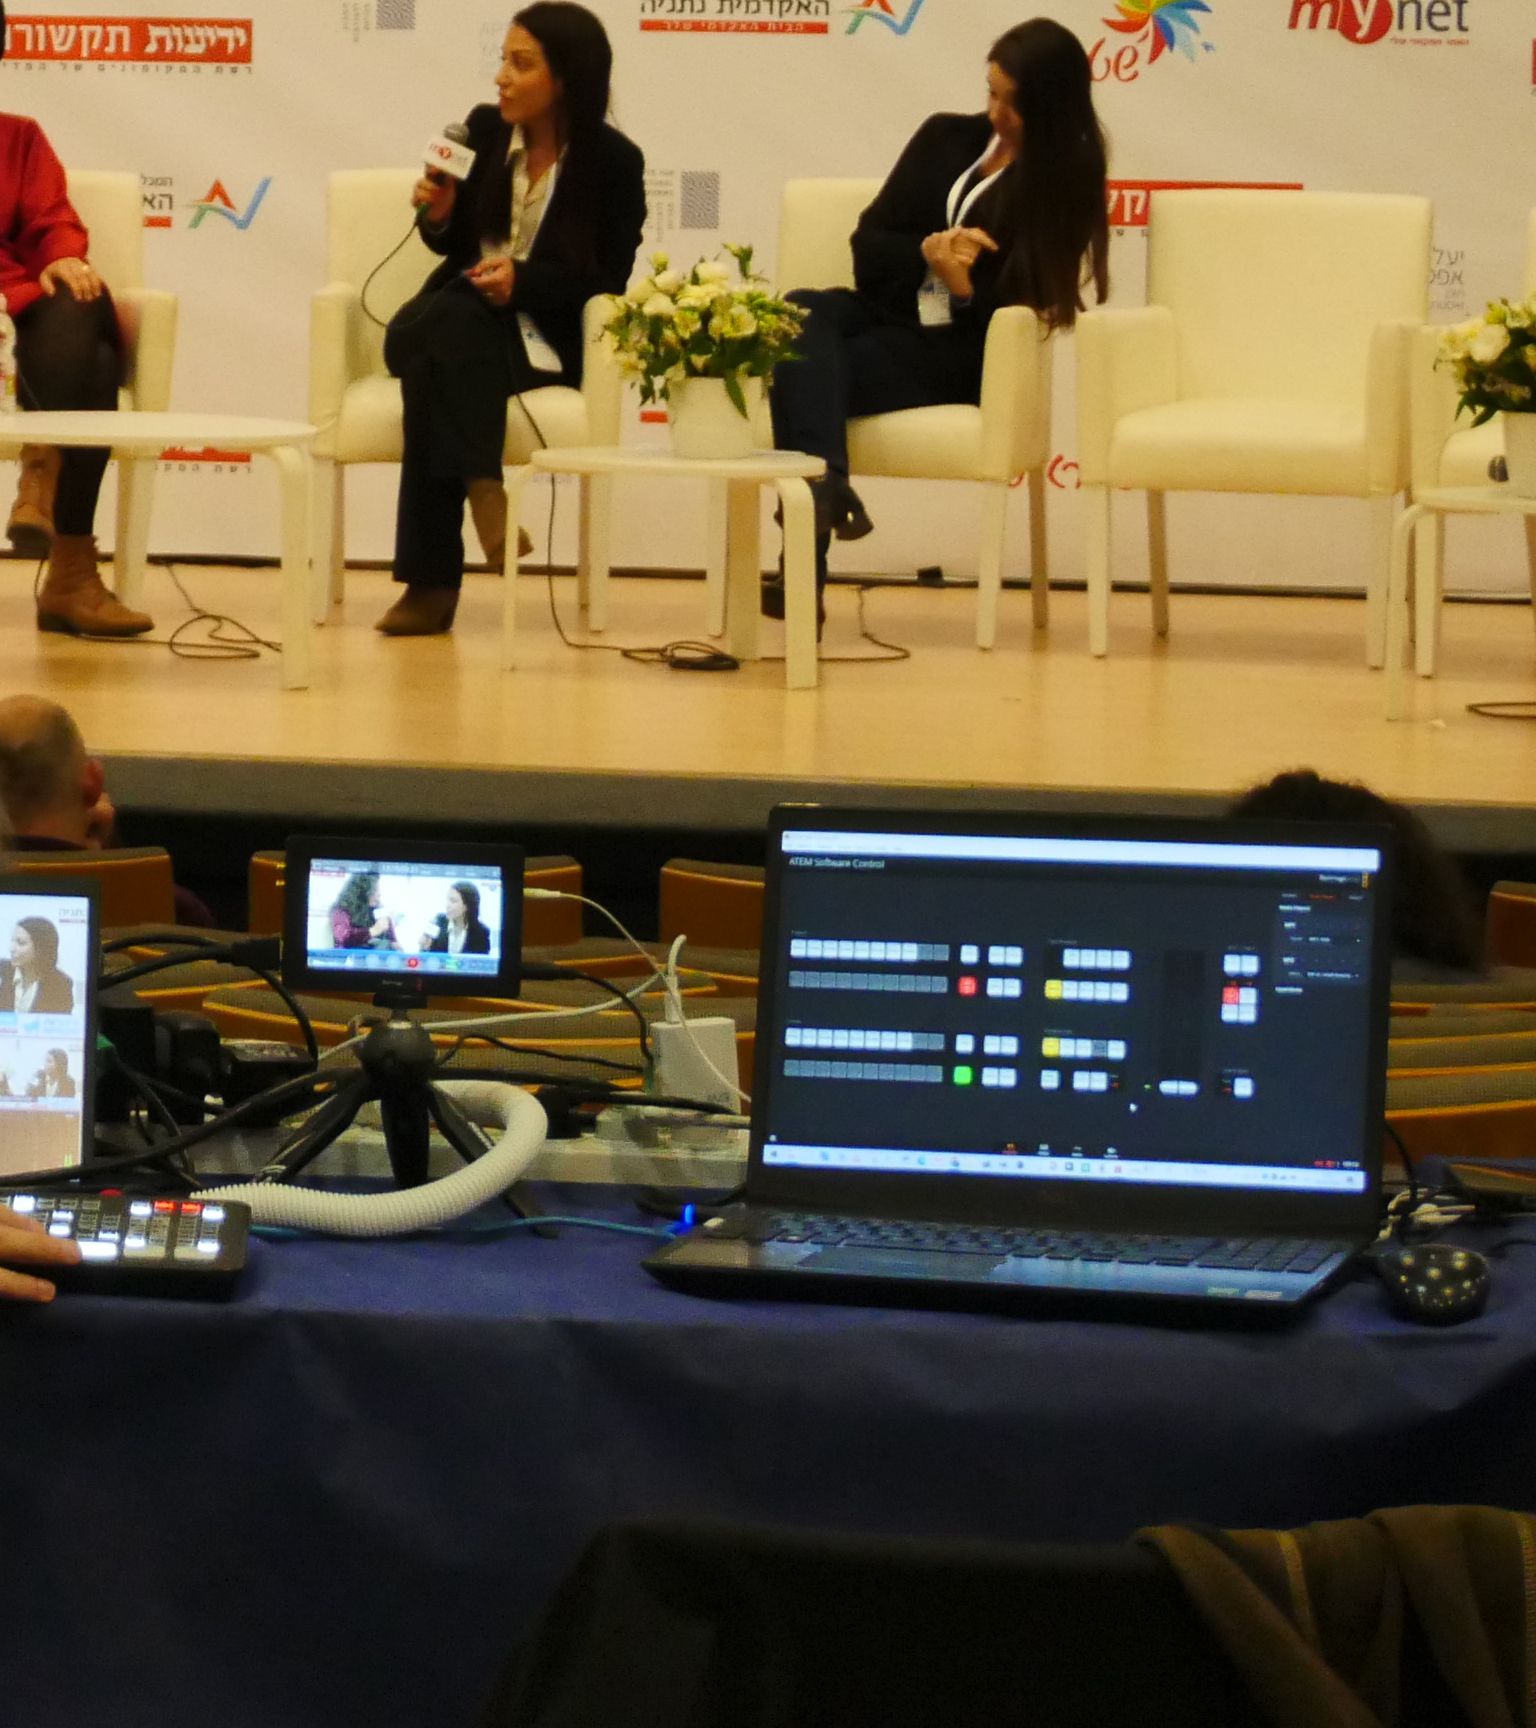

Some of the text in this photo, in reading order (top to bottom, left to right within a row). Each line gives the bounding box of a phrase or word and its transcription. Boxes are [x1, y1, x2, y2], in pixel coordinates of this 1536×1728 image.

[5, 23, 248, 58] ידיעות תקשור
[1433, 247, 1465, 266] יעל
[788, 857, 885, 869] ATEM Software Control
